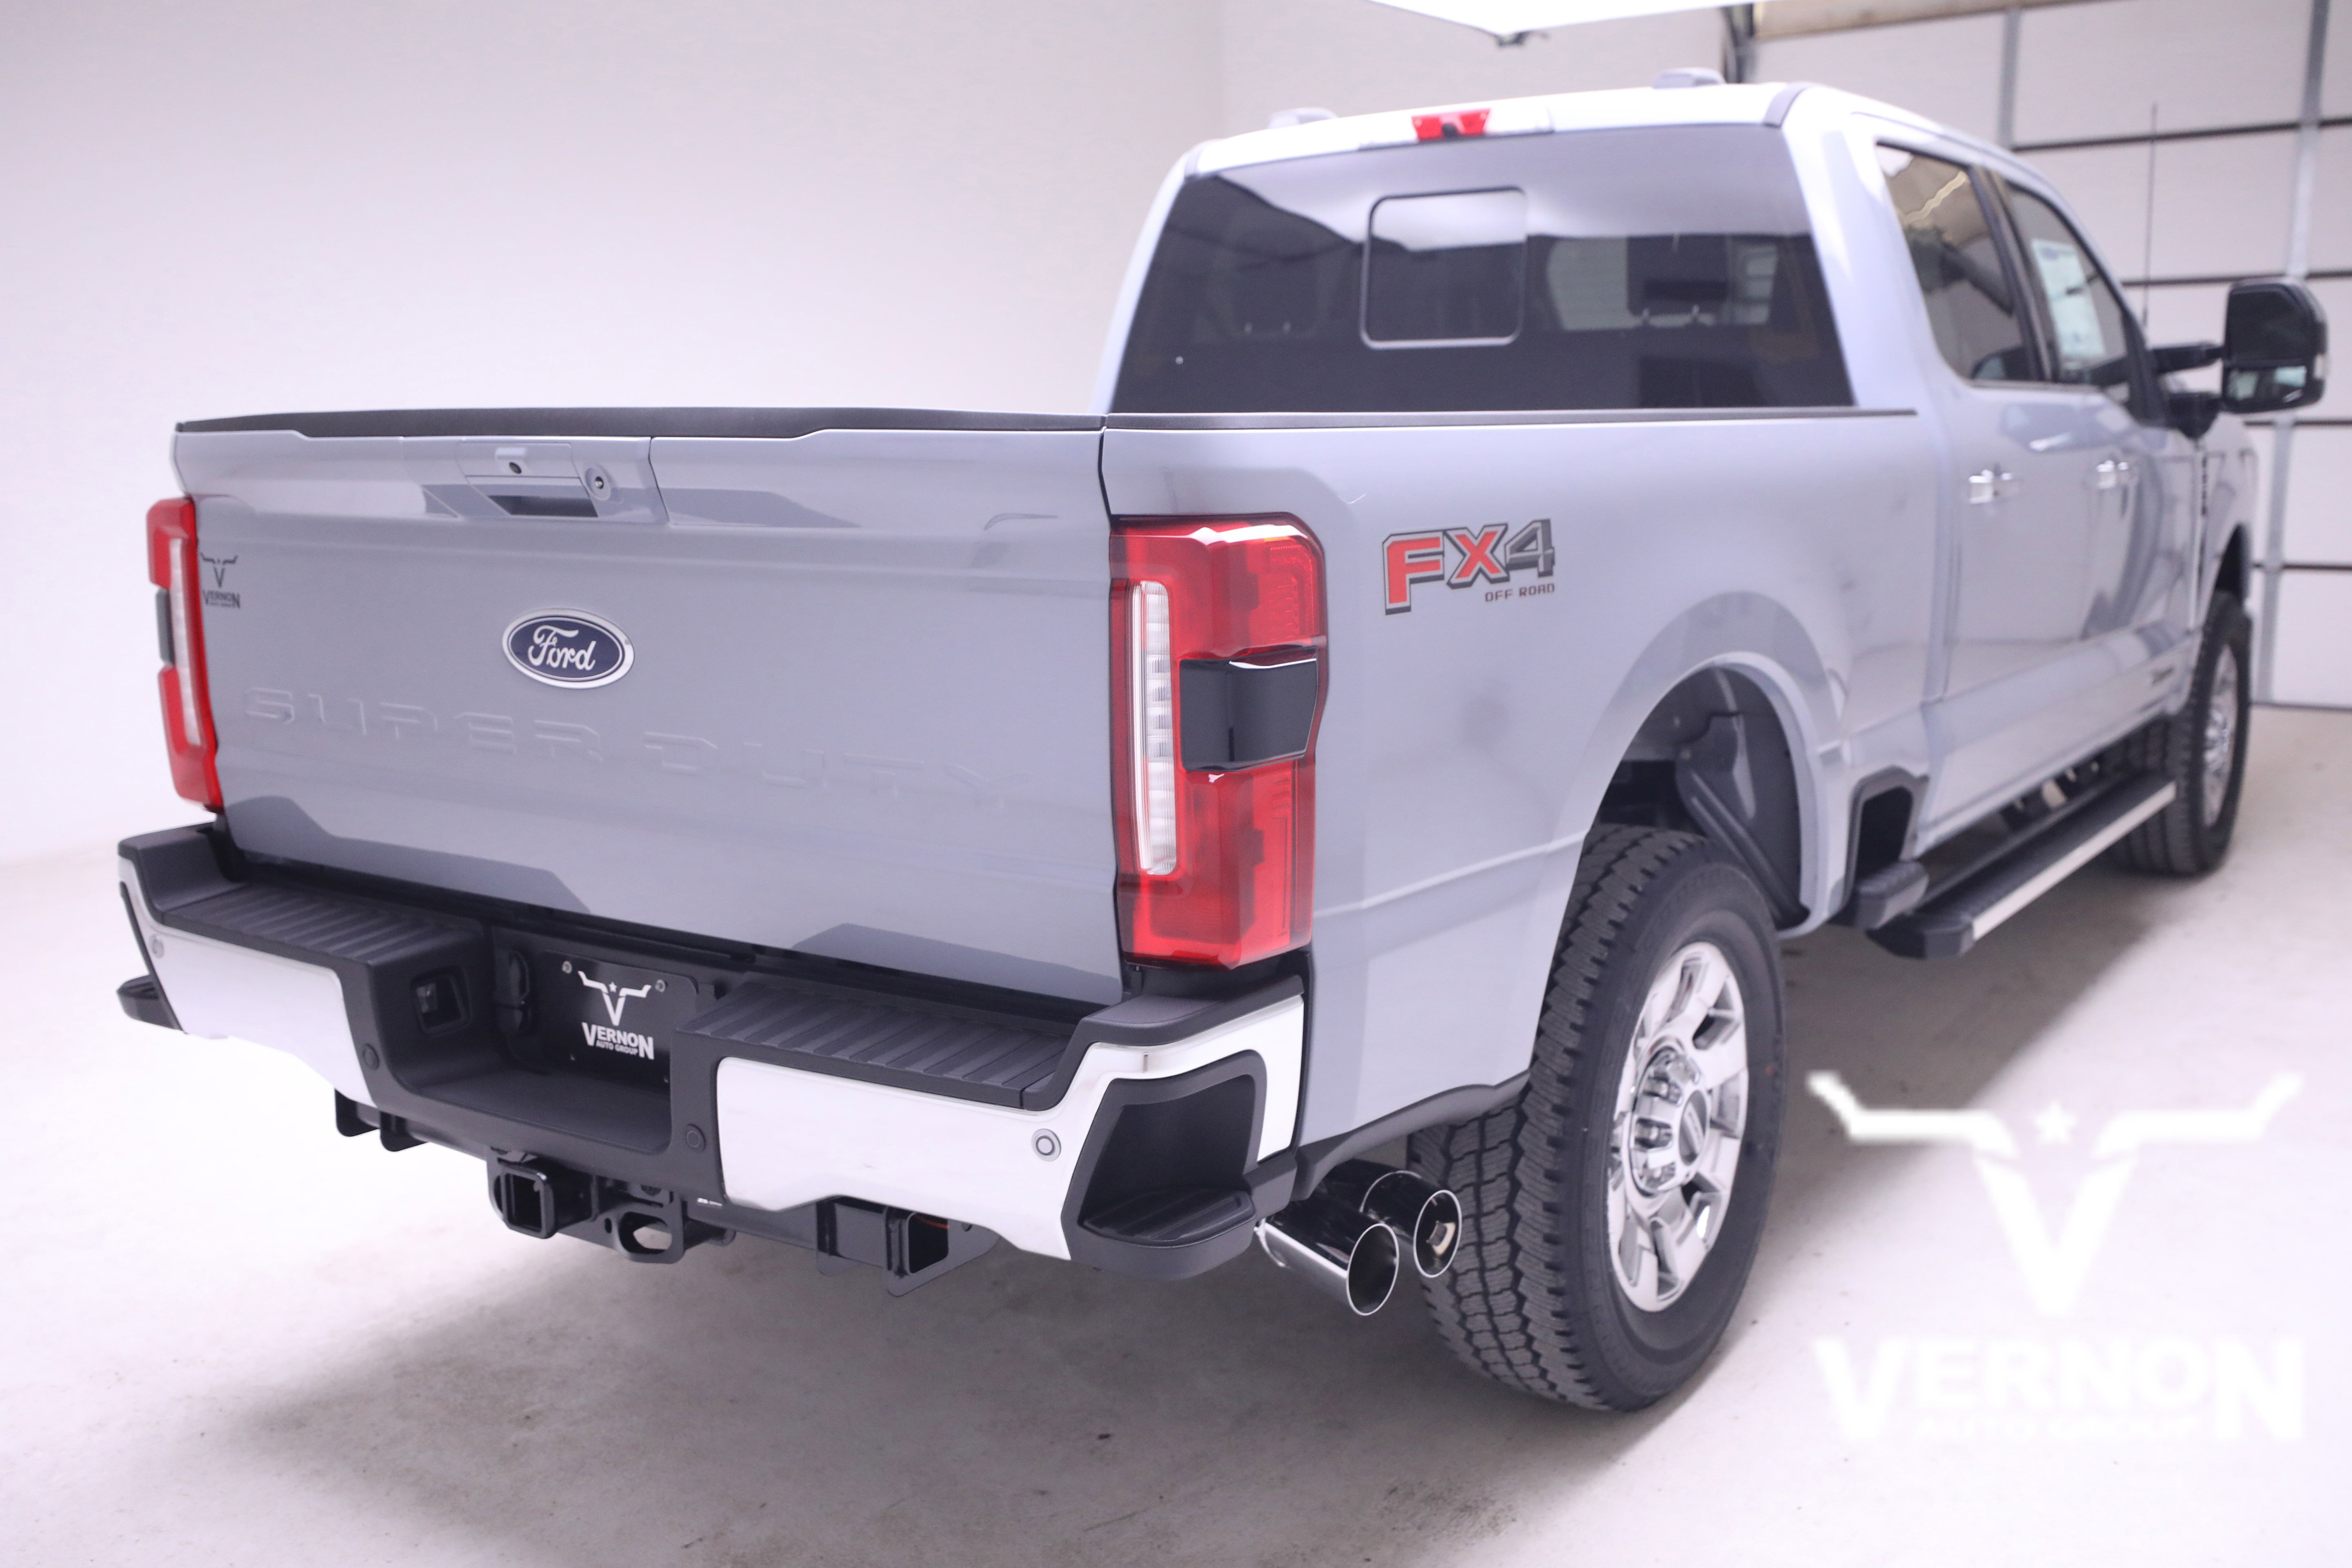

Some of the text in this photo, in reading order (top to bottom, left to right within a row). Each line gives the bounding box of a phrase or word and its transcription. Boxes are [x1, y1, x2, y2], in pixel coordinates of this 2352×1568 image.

[1382, 518, 1555, 616] FX4
[1485, 583, 1555, 602] OFF ROAD
[528, 625, 597, 671] Ford
[245, 686, 604, 763] SUPER
[581, 1022, 654, 1060] VERNON
[596, 1040, 638, 1055] AUTO GROUP
